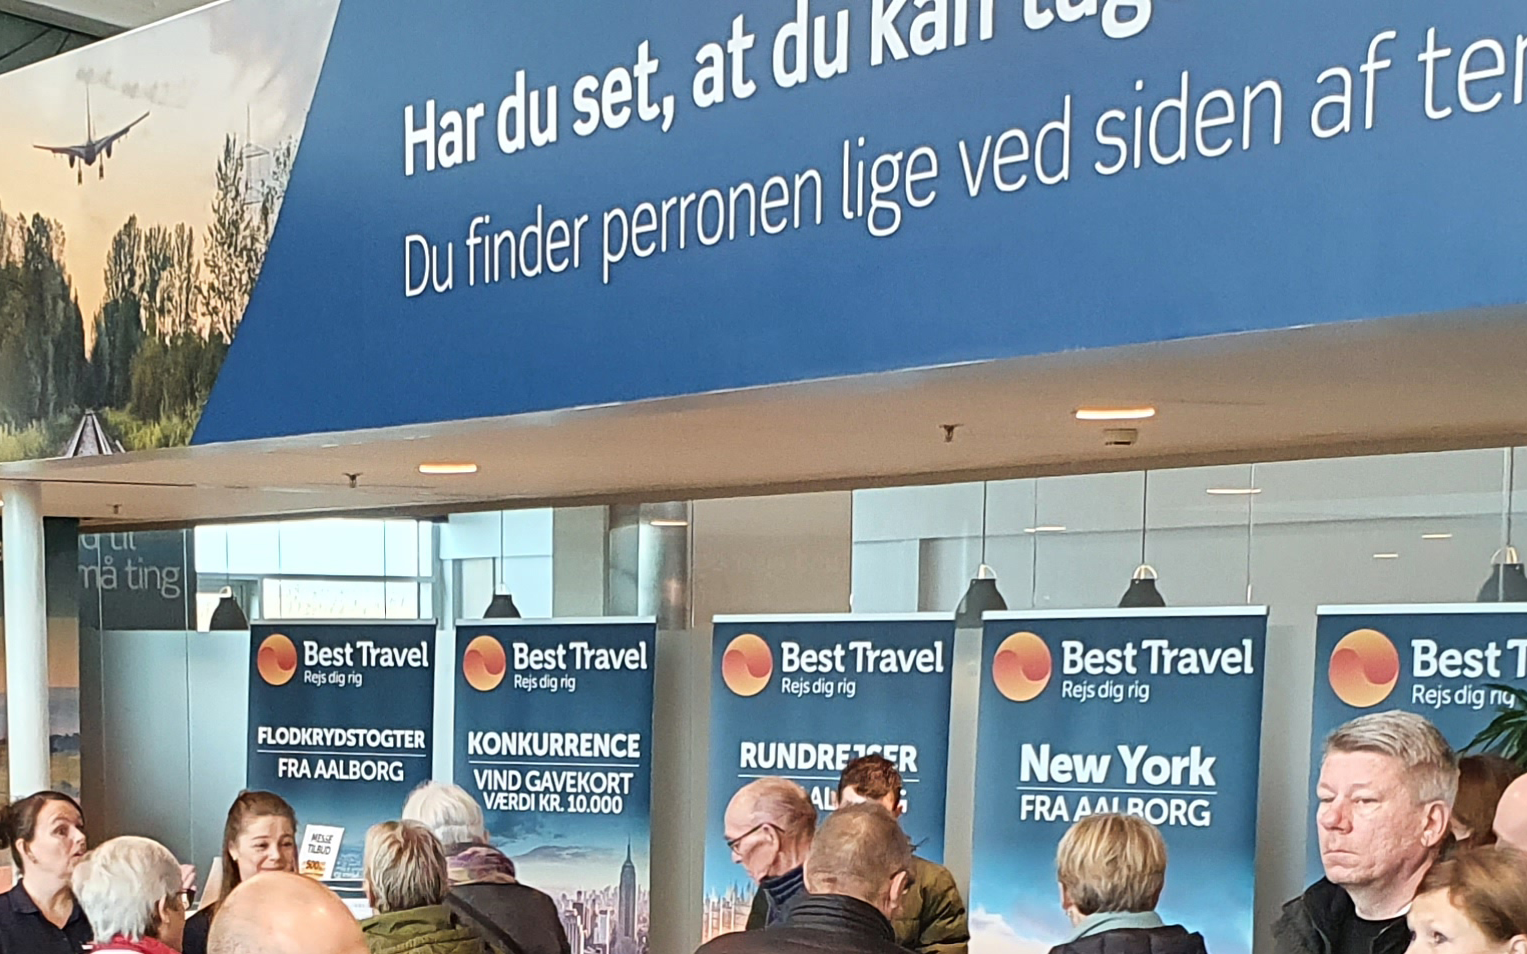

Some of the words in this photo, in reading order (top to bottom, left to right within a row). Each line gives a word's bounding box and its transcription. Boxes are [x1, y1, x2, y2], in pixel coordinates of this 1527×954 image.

[404, 99, 484, 176] Har
[497, 70, 558, 154] du
[573, 40, 675, 136] set,
[692, 14, 757, 108] at
[774, 0, 849, 88] du
[404, 234, 455, 297] Du
[465, 204, 588, 286] finder
[602, 168, 822, 285] perronen
[841, 137, 939, 237] lige
[958, 95, 1071, 198] ved
[1094, 70, 1283, 176] siden
[1310, 30, 1397, 139] af
[78, 555, 118, 590] må
[125, 557, 180, 599] ting
[303, 641, 353, 667] Best
[357, 641, 428, 668] Travel
[513, 642, 569, 670] Best
[572, 641, 647, 670] Travel
[781, 642, 845, 672] Best
[849, 641, 944, 673] Travel
[1062, 640, 1137, 674] Best
[1142, 639, 1253, 675] Travel
[1411, 639, 1501, 678] Best
[304, 671, 327, 686] Rejs
[328, 670, 346, 687] dig
[348, 671, 362, 687] rig
[514, 674, 538, 690] Rejs
[539, 674, 557, 691] dig
[559, 674, 575, 692] rig
[782, 678, 810, 697] Rejs
[812, 677, 835, 698] dig
[837, 679, 856, 698] rig
[1062, 680, 1094, 702] Rejs
[1096, 680, 1125, 703] dig
[1128, 680, 1150, 703] rig
[1412, 684, 1451, 709] Rejs
[1454, 684, 1485, 710] dig
[257, 726, 426, 749] FLODKRYDSTOGTER
[468, 731, 640, 758] KONKURRENCE
[278, 758, 311, 779] FRA
[314, 759, 404, 782] AALBORG
[1020, 744, 1111, 785] New
[1117, 744, 1216, 787] York
[474, 770, 522, 792] VIND
[524, 771, 634, 794] GAVEKORT
[483, 791, 536, 811] VÆRDI
[539, 793, 564, 812] KR.
[567, 794, 623, 814] 10.000
[1020, 794, 1069, 822] FRA
